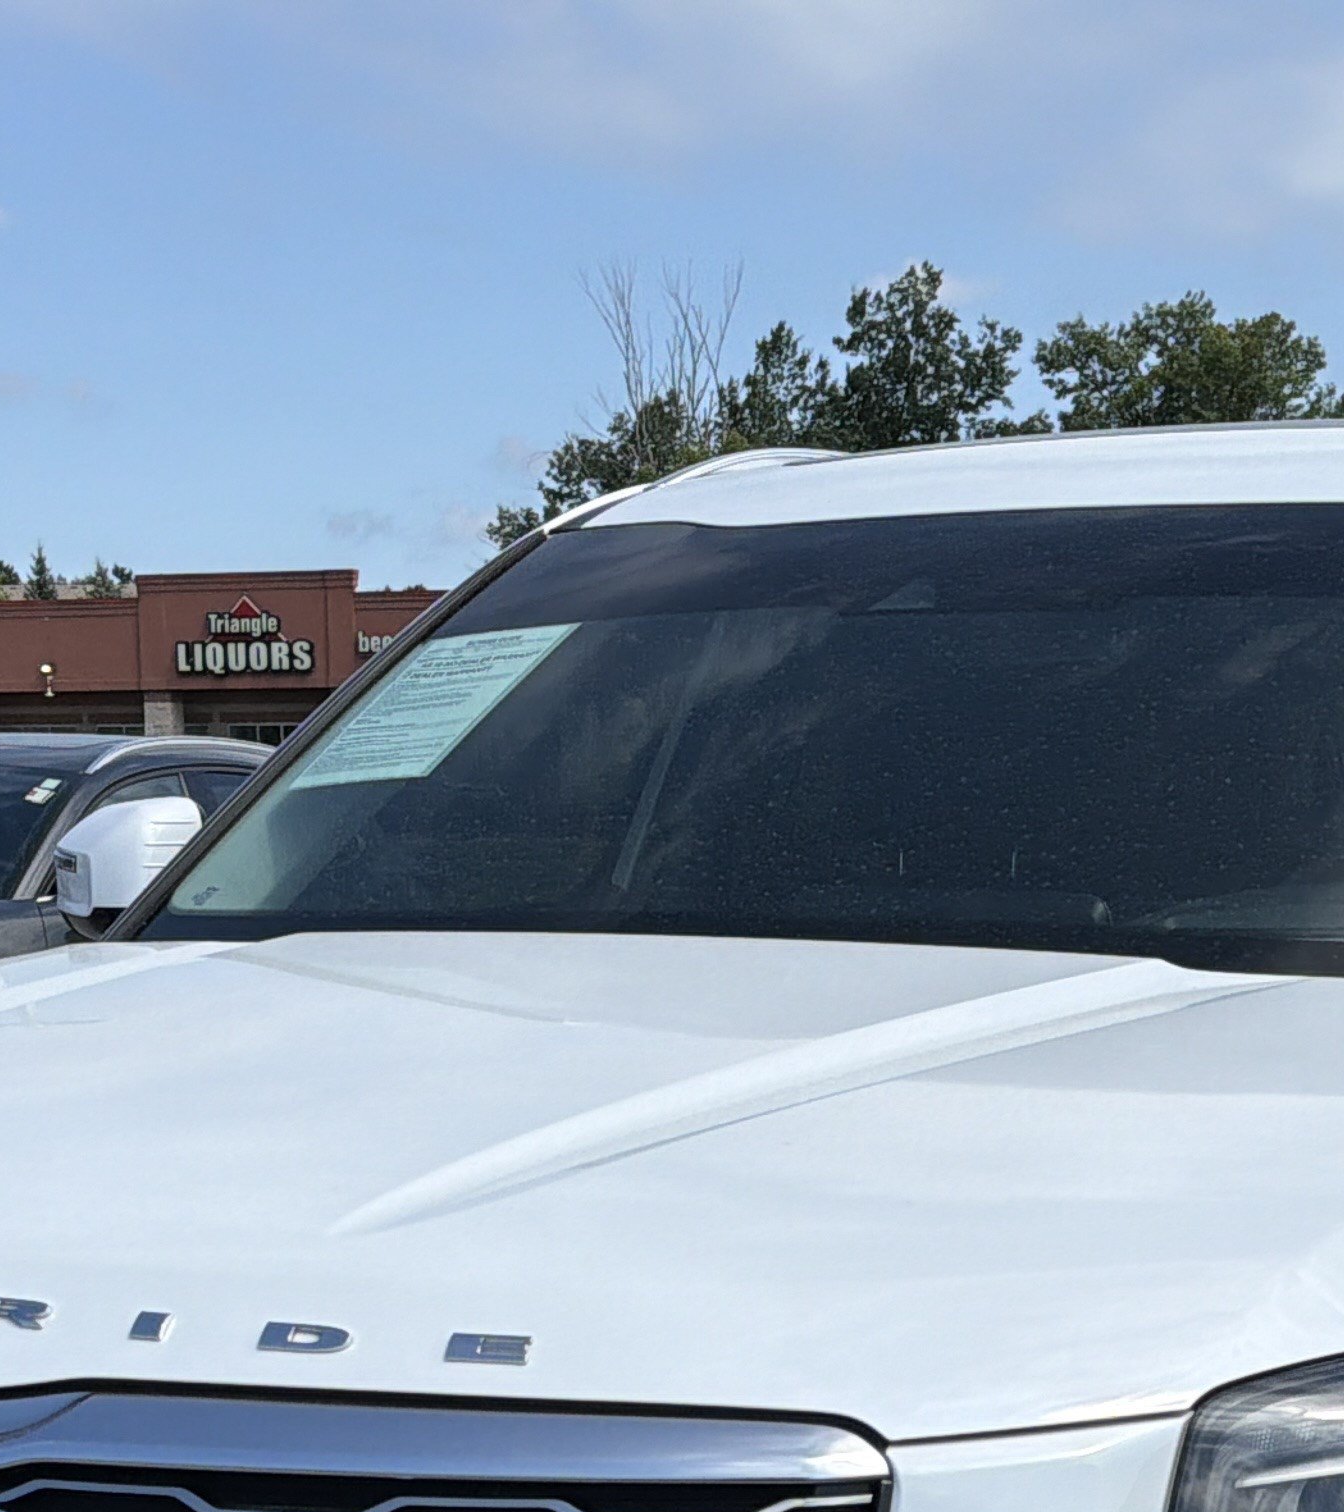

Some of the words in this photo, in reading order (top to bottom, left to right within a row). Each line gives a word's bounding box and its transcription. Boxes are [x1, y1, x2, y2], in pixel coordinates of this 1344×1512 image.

[208, 612, 278, 637] Triangle
[358, 631, 396, 653] bee
[176, 641, 312, 674] LIQUORS
